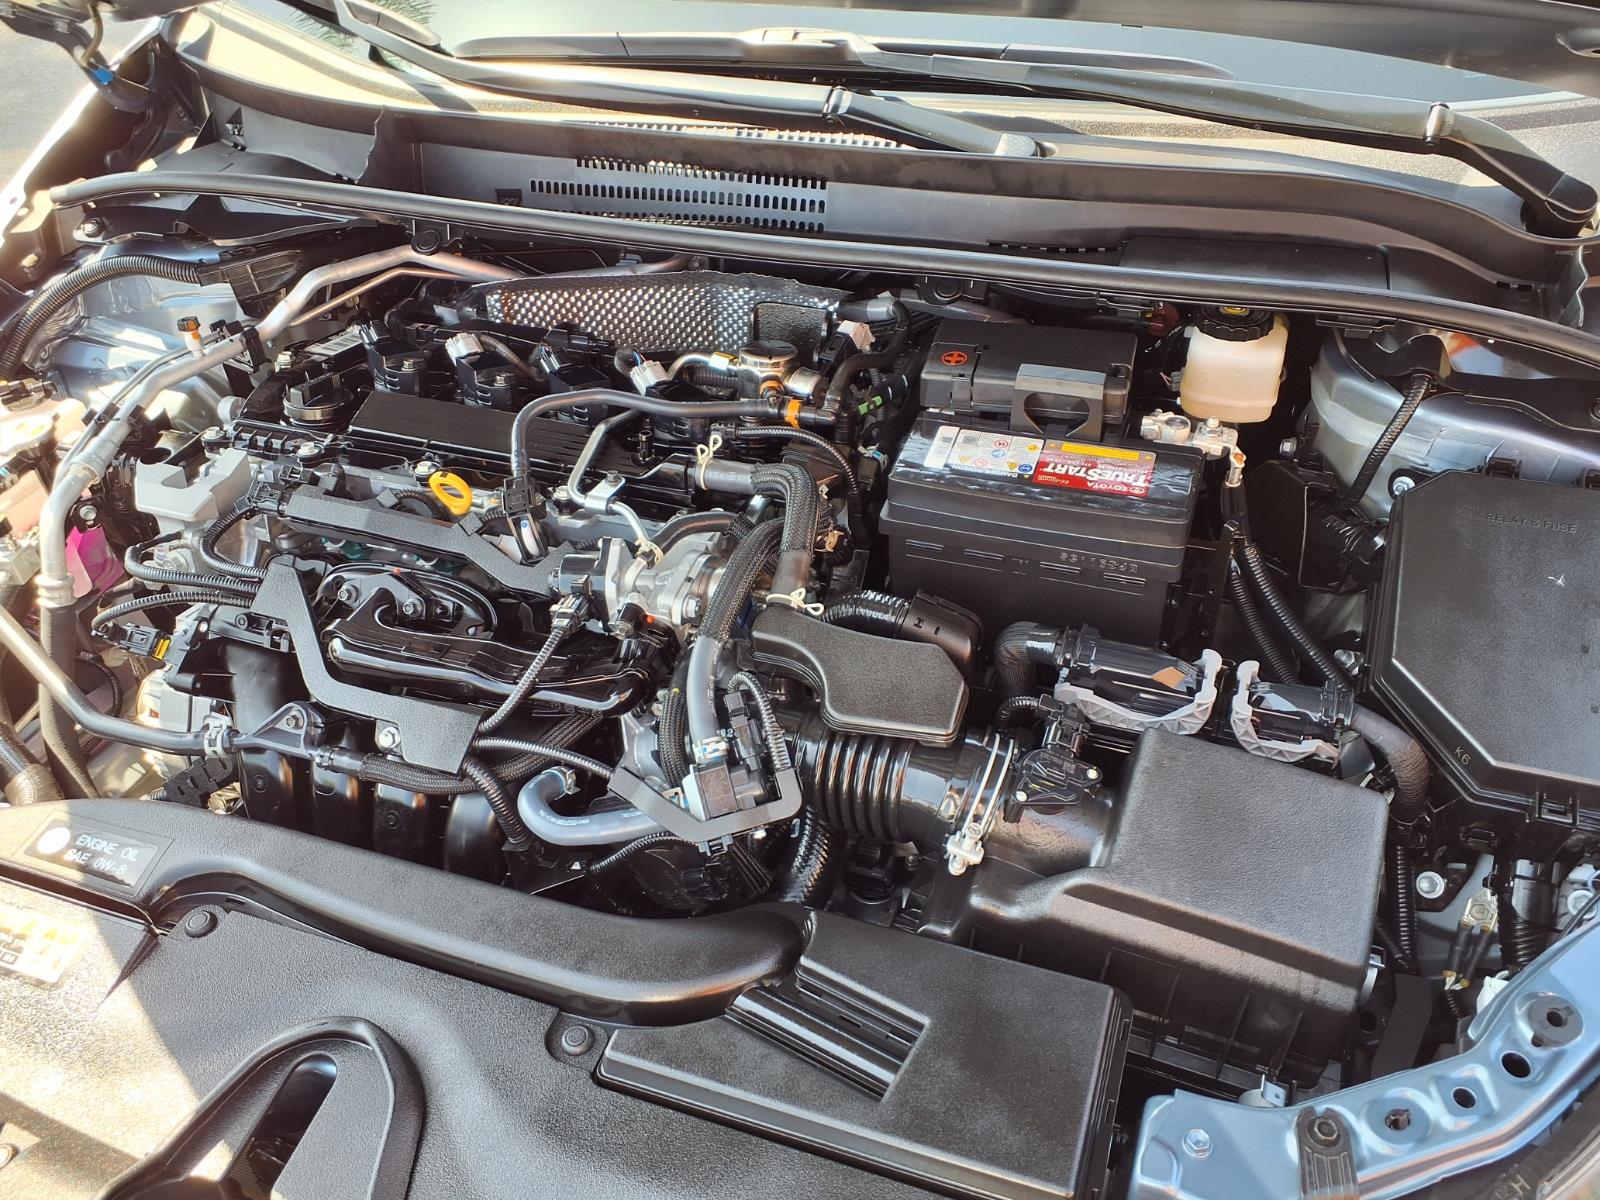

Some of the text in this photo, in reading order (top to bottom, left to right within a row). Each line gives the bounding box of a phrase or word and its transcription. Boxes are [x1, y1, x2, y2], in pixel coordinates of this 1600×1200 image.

[1087, 481, 1130, 492] TOYOTA
[1486, 512, 1527, 526] RELAY
[1543, 519, 1577, 534] FUSE
[1454, 746, 1471, 765] K6
[63, 848, 92, 864] SAE
[75, 834, 139, 862] ENGINE OIL
